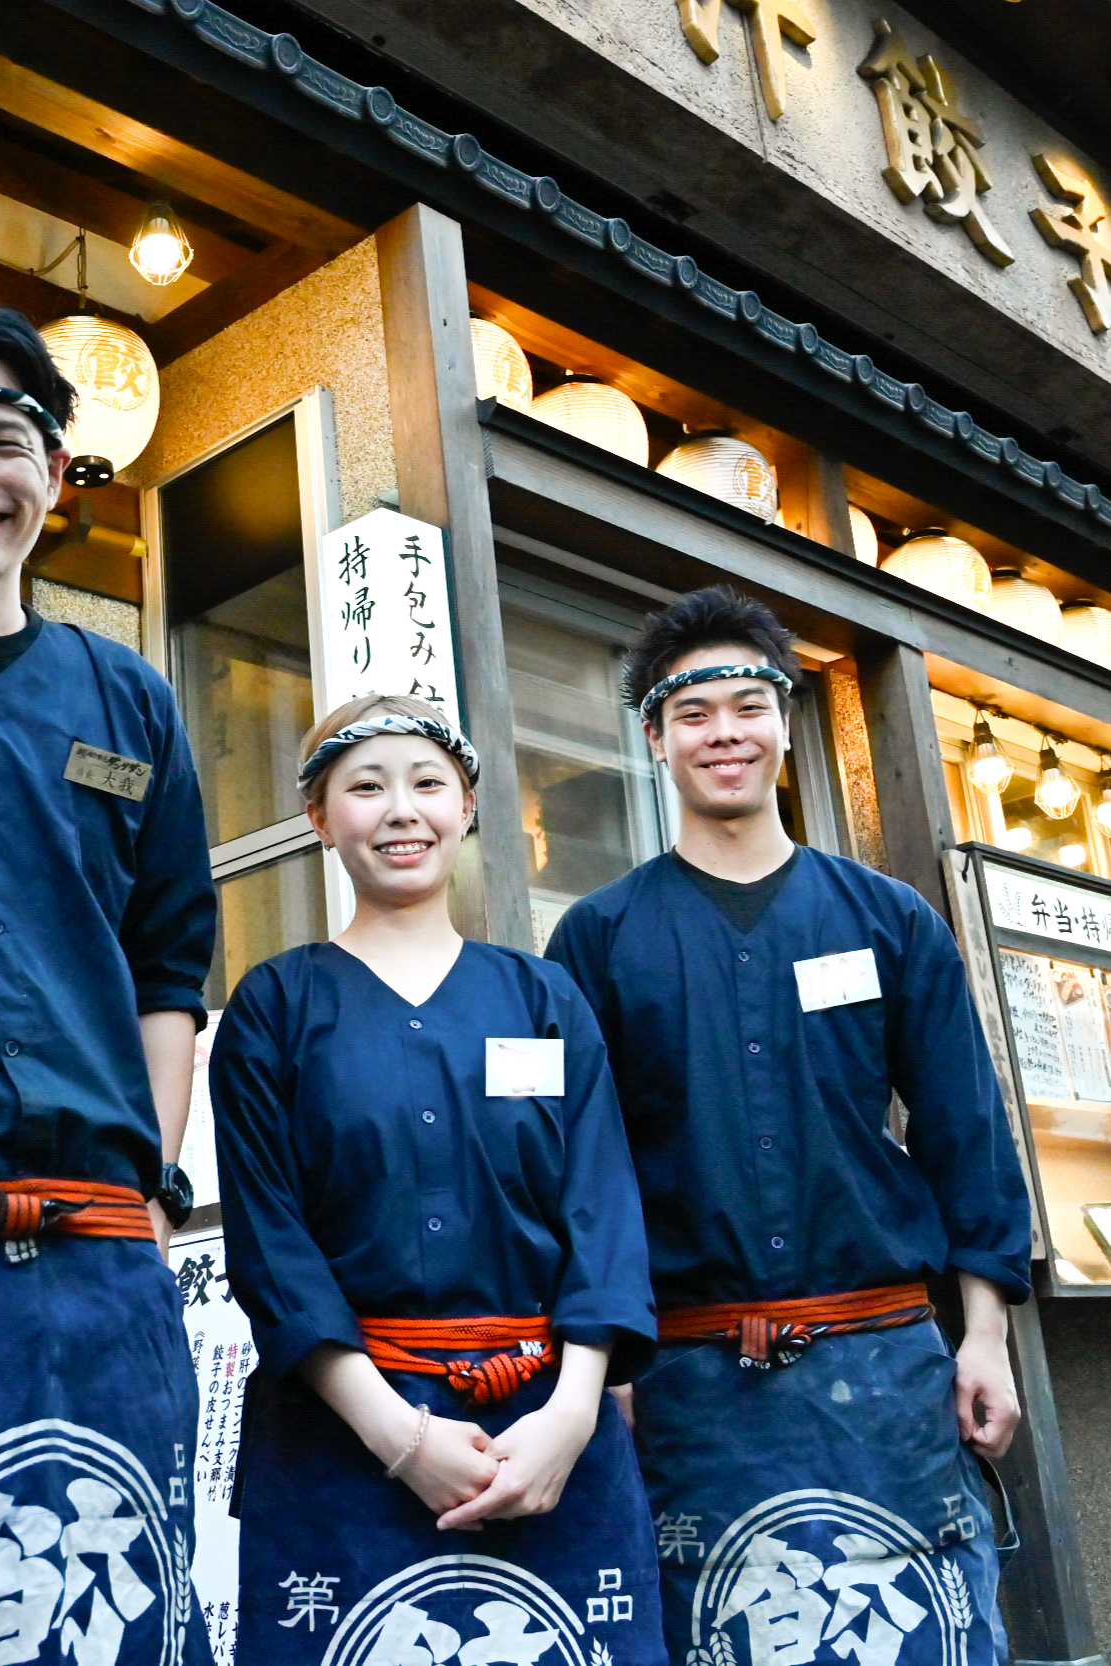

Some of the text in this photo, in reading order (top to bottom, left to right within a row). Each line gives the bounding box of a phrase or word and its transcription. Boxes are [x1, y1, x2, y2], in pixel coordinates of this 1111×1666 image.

[338, 535, 376, 697] 持帰り
[196, 1344, 225, 1483] 餃子の皮せんべい
[653, 1511, 706, 1564] 第
[277, 1570, 341, 1632] 第
[586, 1568, 634, 1623] 品
